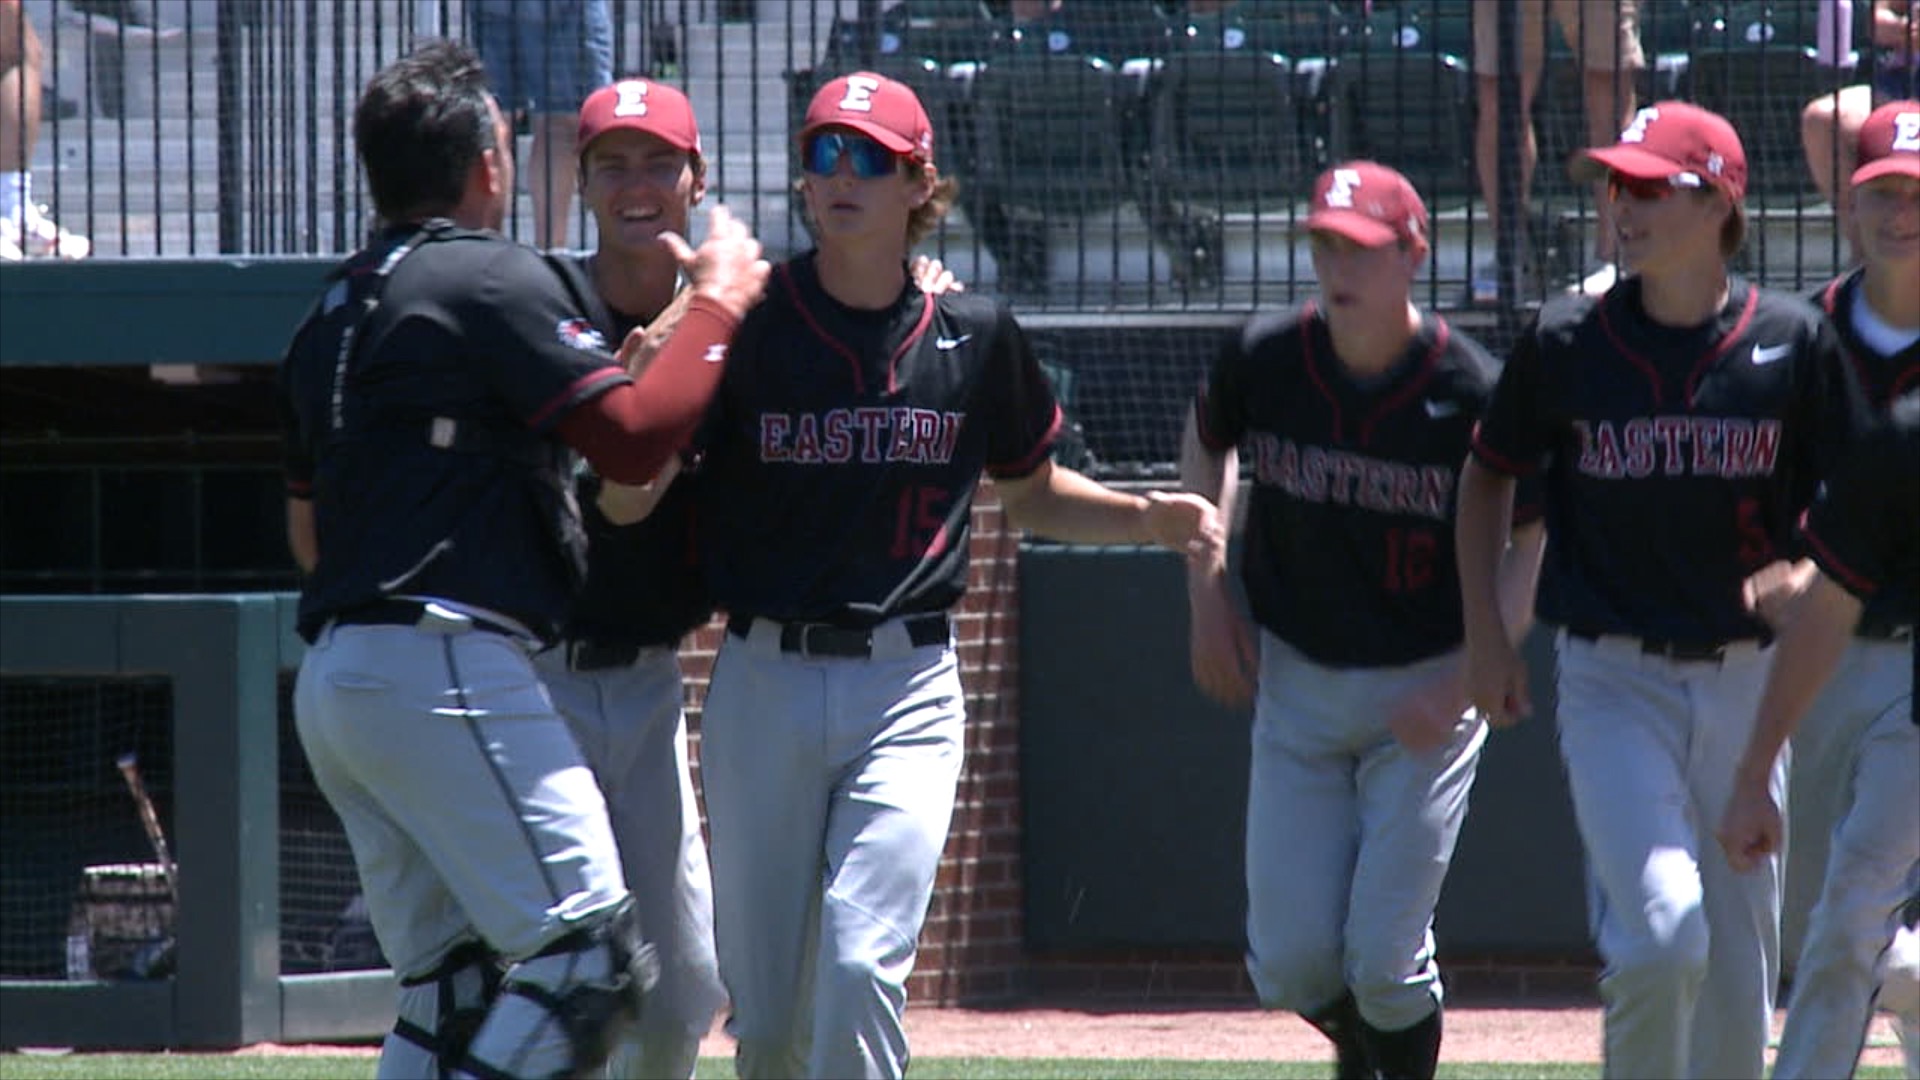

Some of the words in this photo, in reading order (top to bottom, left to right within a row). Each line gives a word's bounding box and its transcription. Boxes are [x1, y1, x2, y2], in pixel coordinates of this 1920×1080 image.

[613, 79, 649, 118] E
[838, 75, 879, 112] E
[1892, 111, 1920, 152] E
[760, 407, 966, 463] EASTERN
